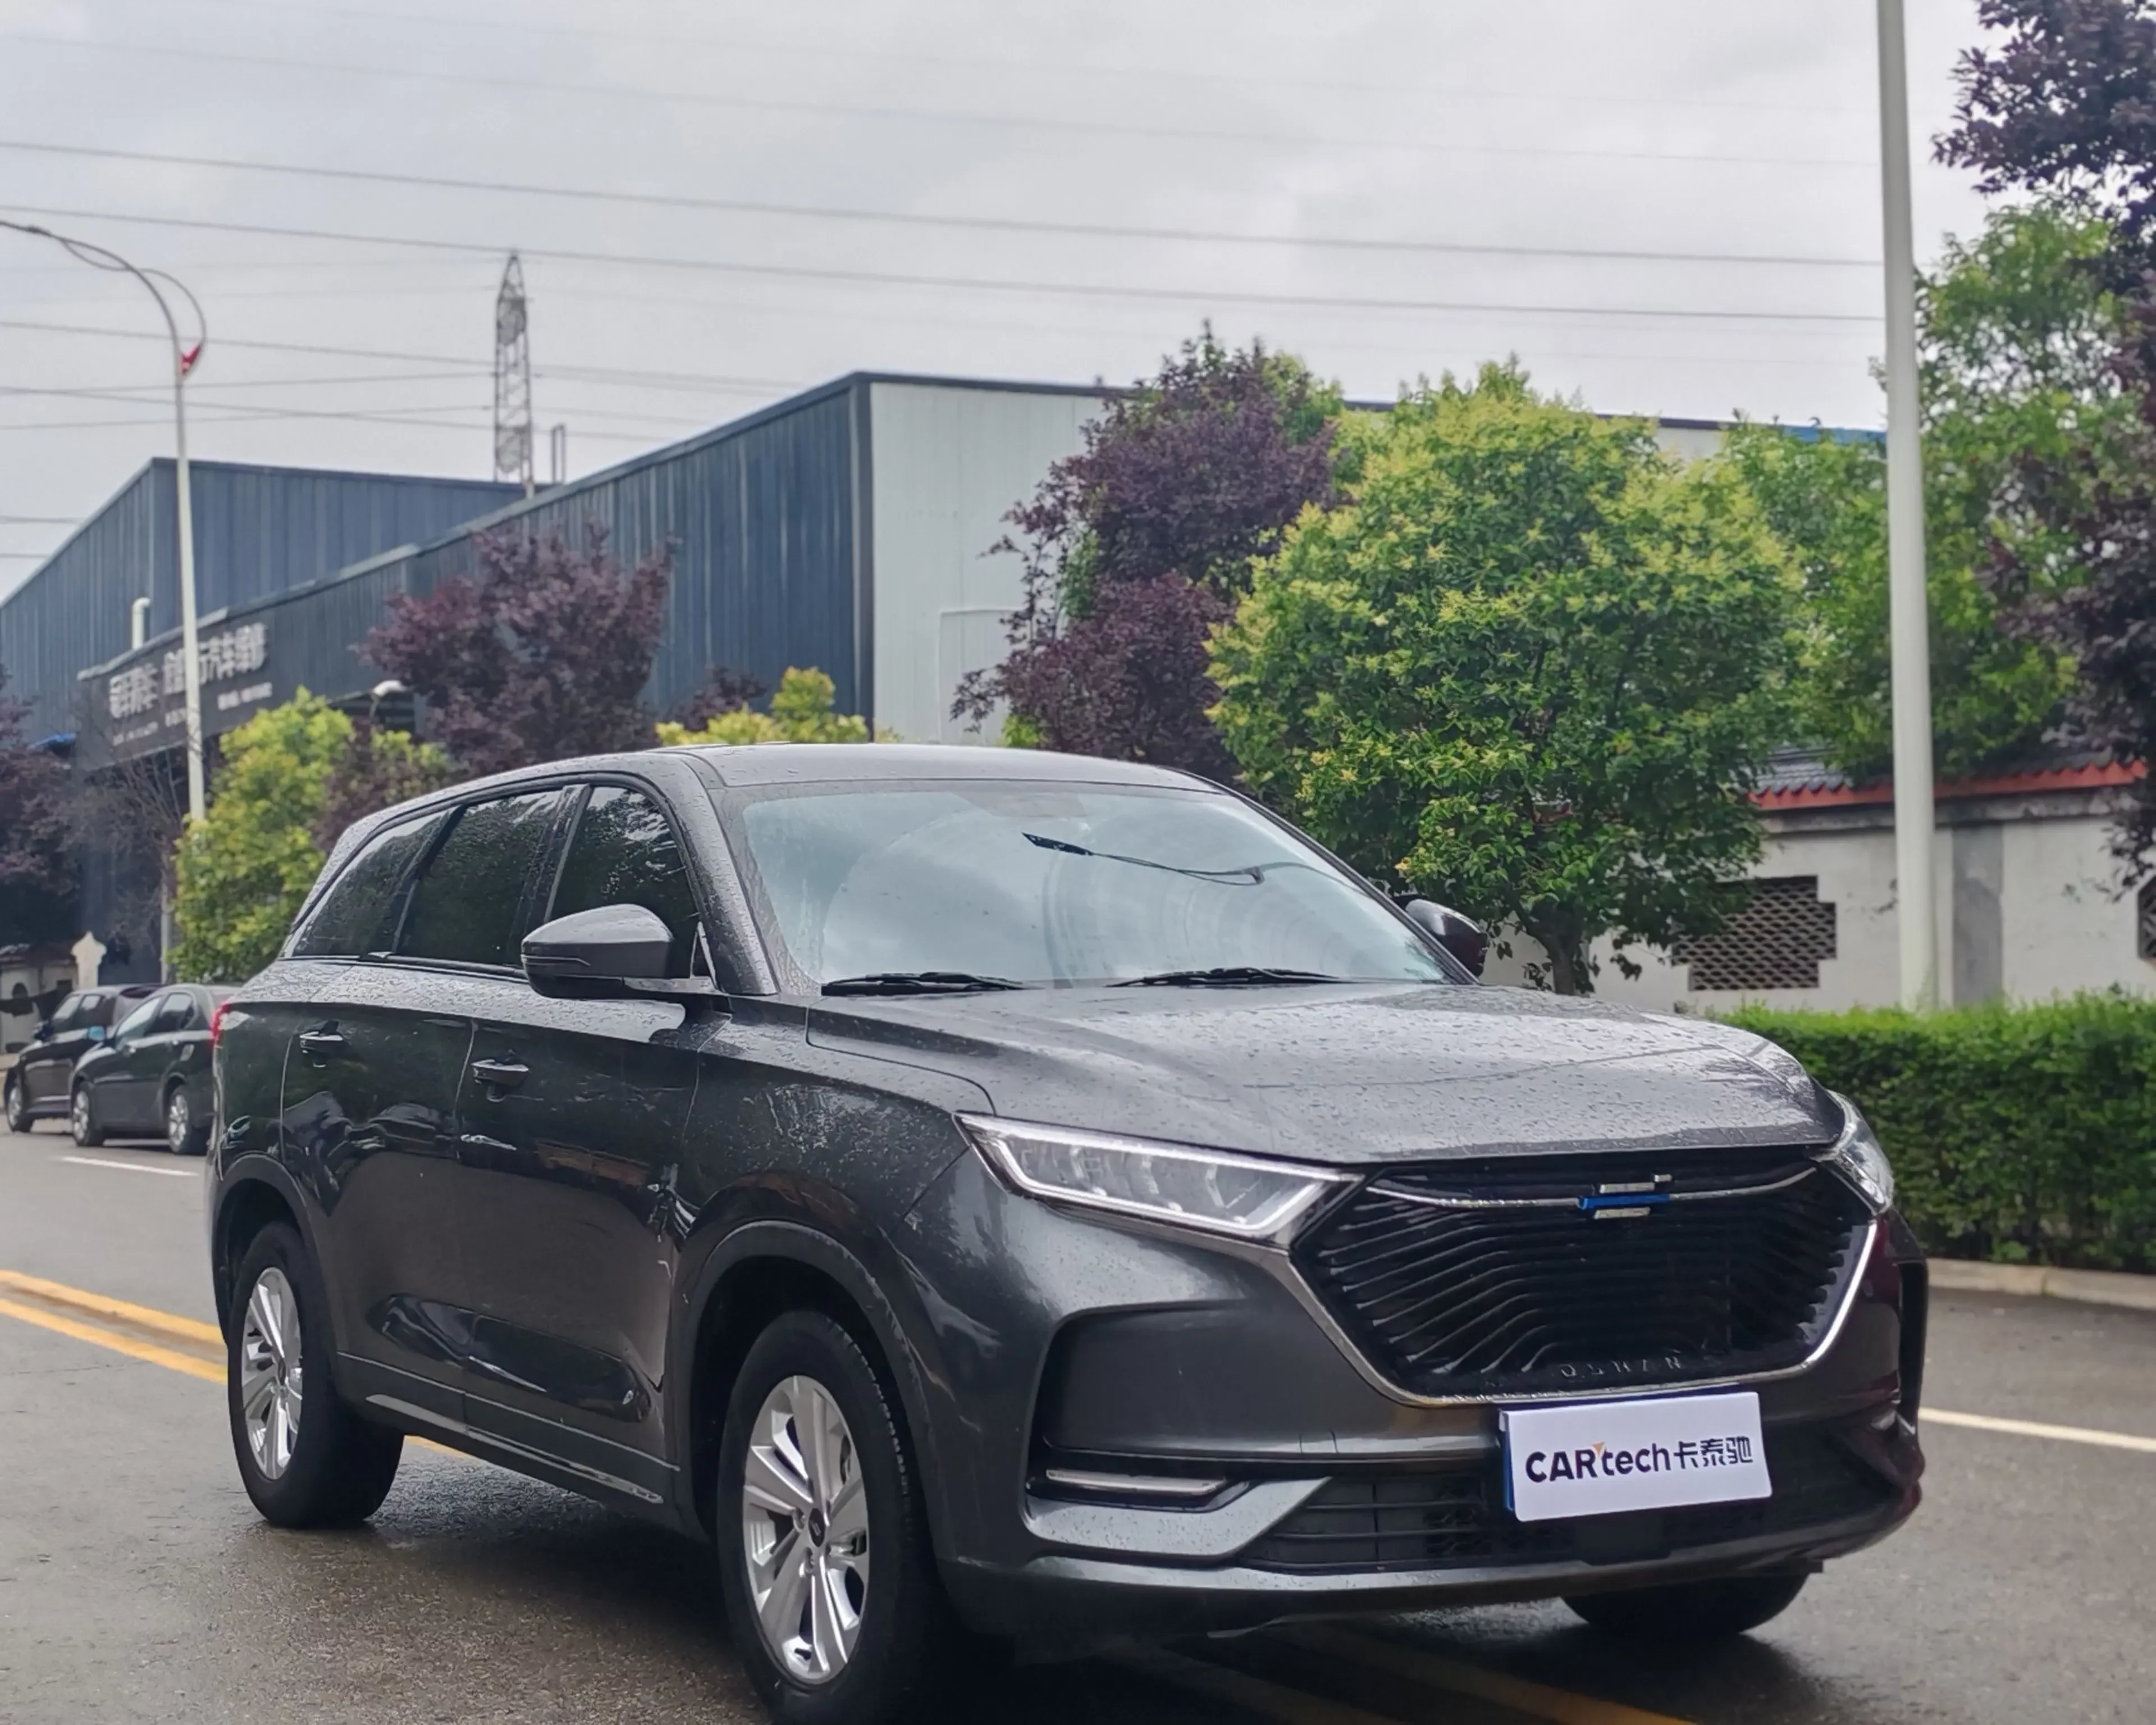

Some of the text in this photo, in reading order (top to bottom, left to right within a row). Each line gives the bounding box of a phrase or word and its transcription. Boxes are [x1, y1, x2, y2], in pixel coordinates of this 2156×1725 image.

[1525, 1436, 1753, 1482] CARtech 卡泰驰
